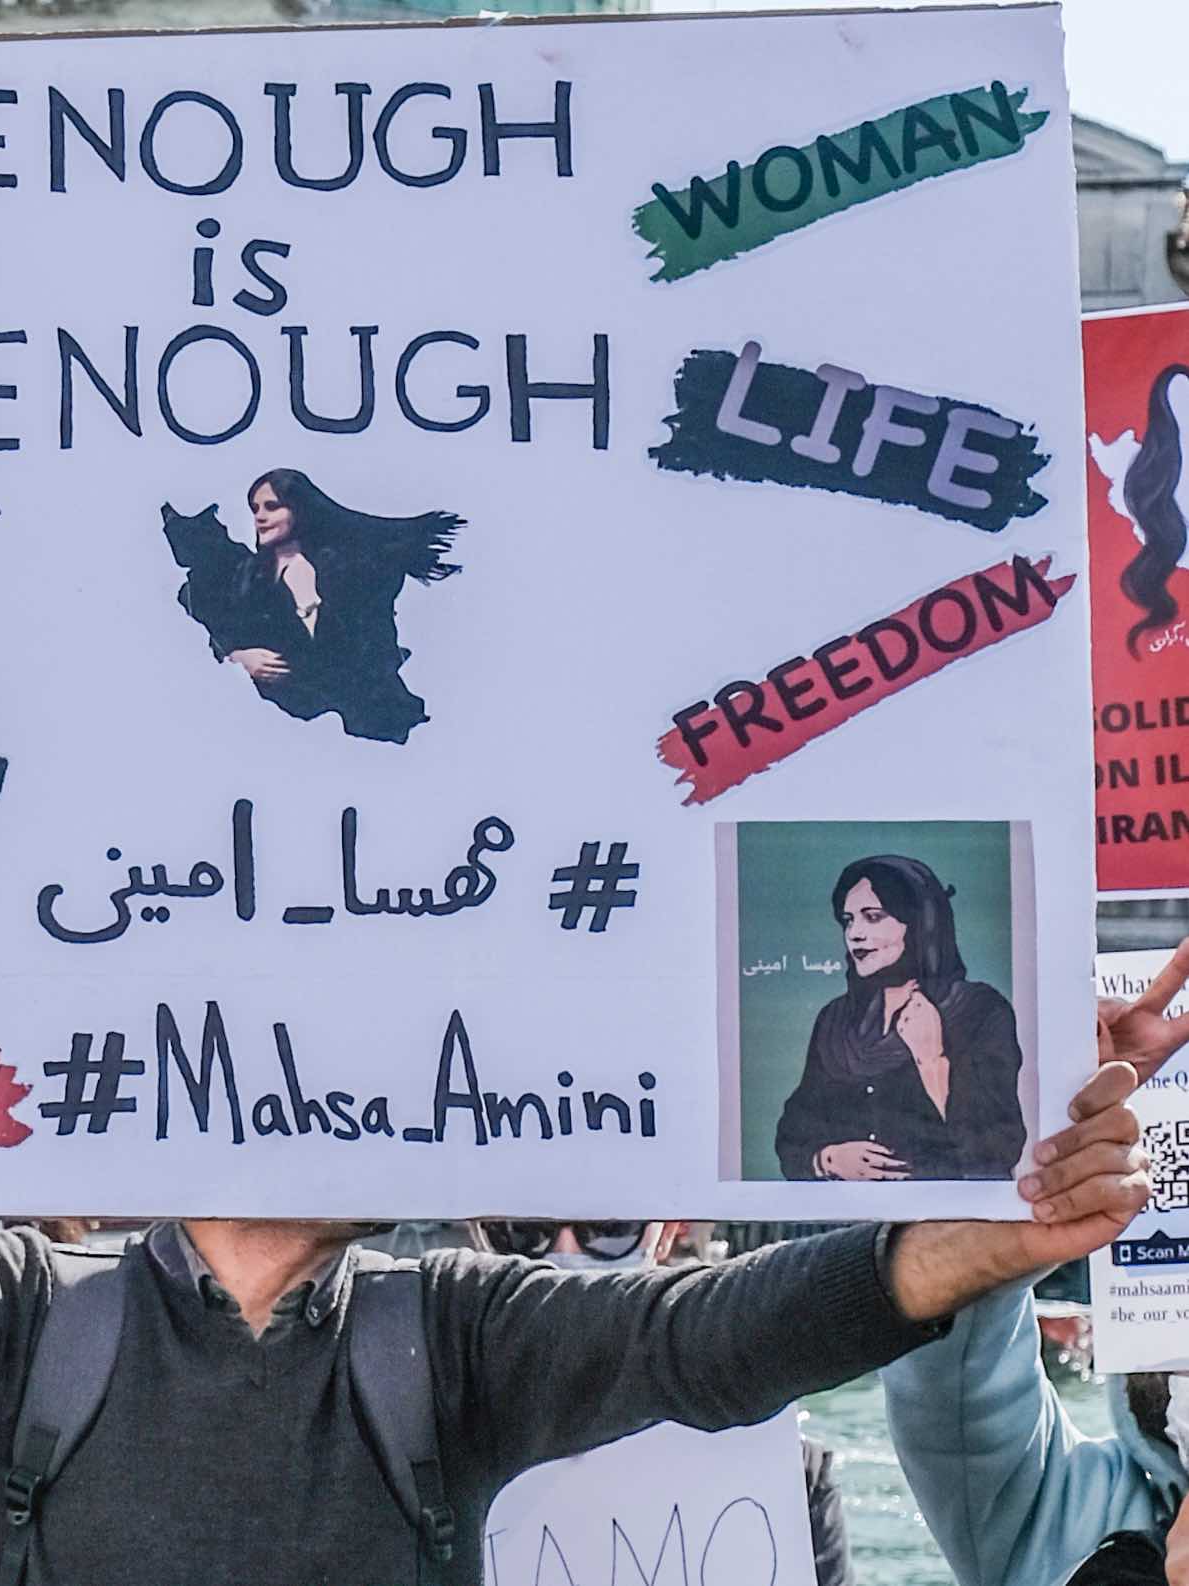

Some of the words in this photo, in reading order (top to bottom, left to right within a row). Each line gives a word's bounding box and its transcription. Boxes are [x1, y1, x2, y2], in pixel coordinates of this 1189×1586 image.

[651, 80, 1024, 240] WOMAN
[192, 217, 291, 316] is
[715, 340, 1020, 509] LIFE
[671, 553, 1058, 767] FREEDOM
[801, 954, 842, 975] مهسا
[38, 1000, 657, 1145] #Mahsa_Amini
[1136, 1244, 1175, 1260] Scan
